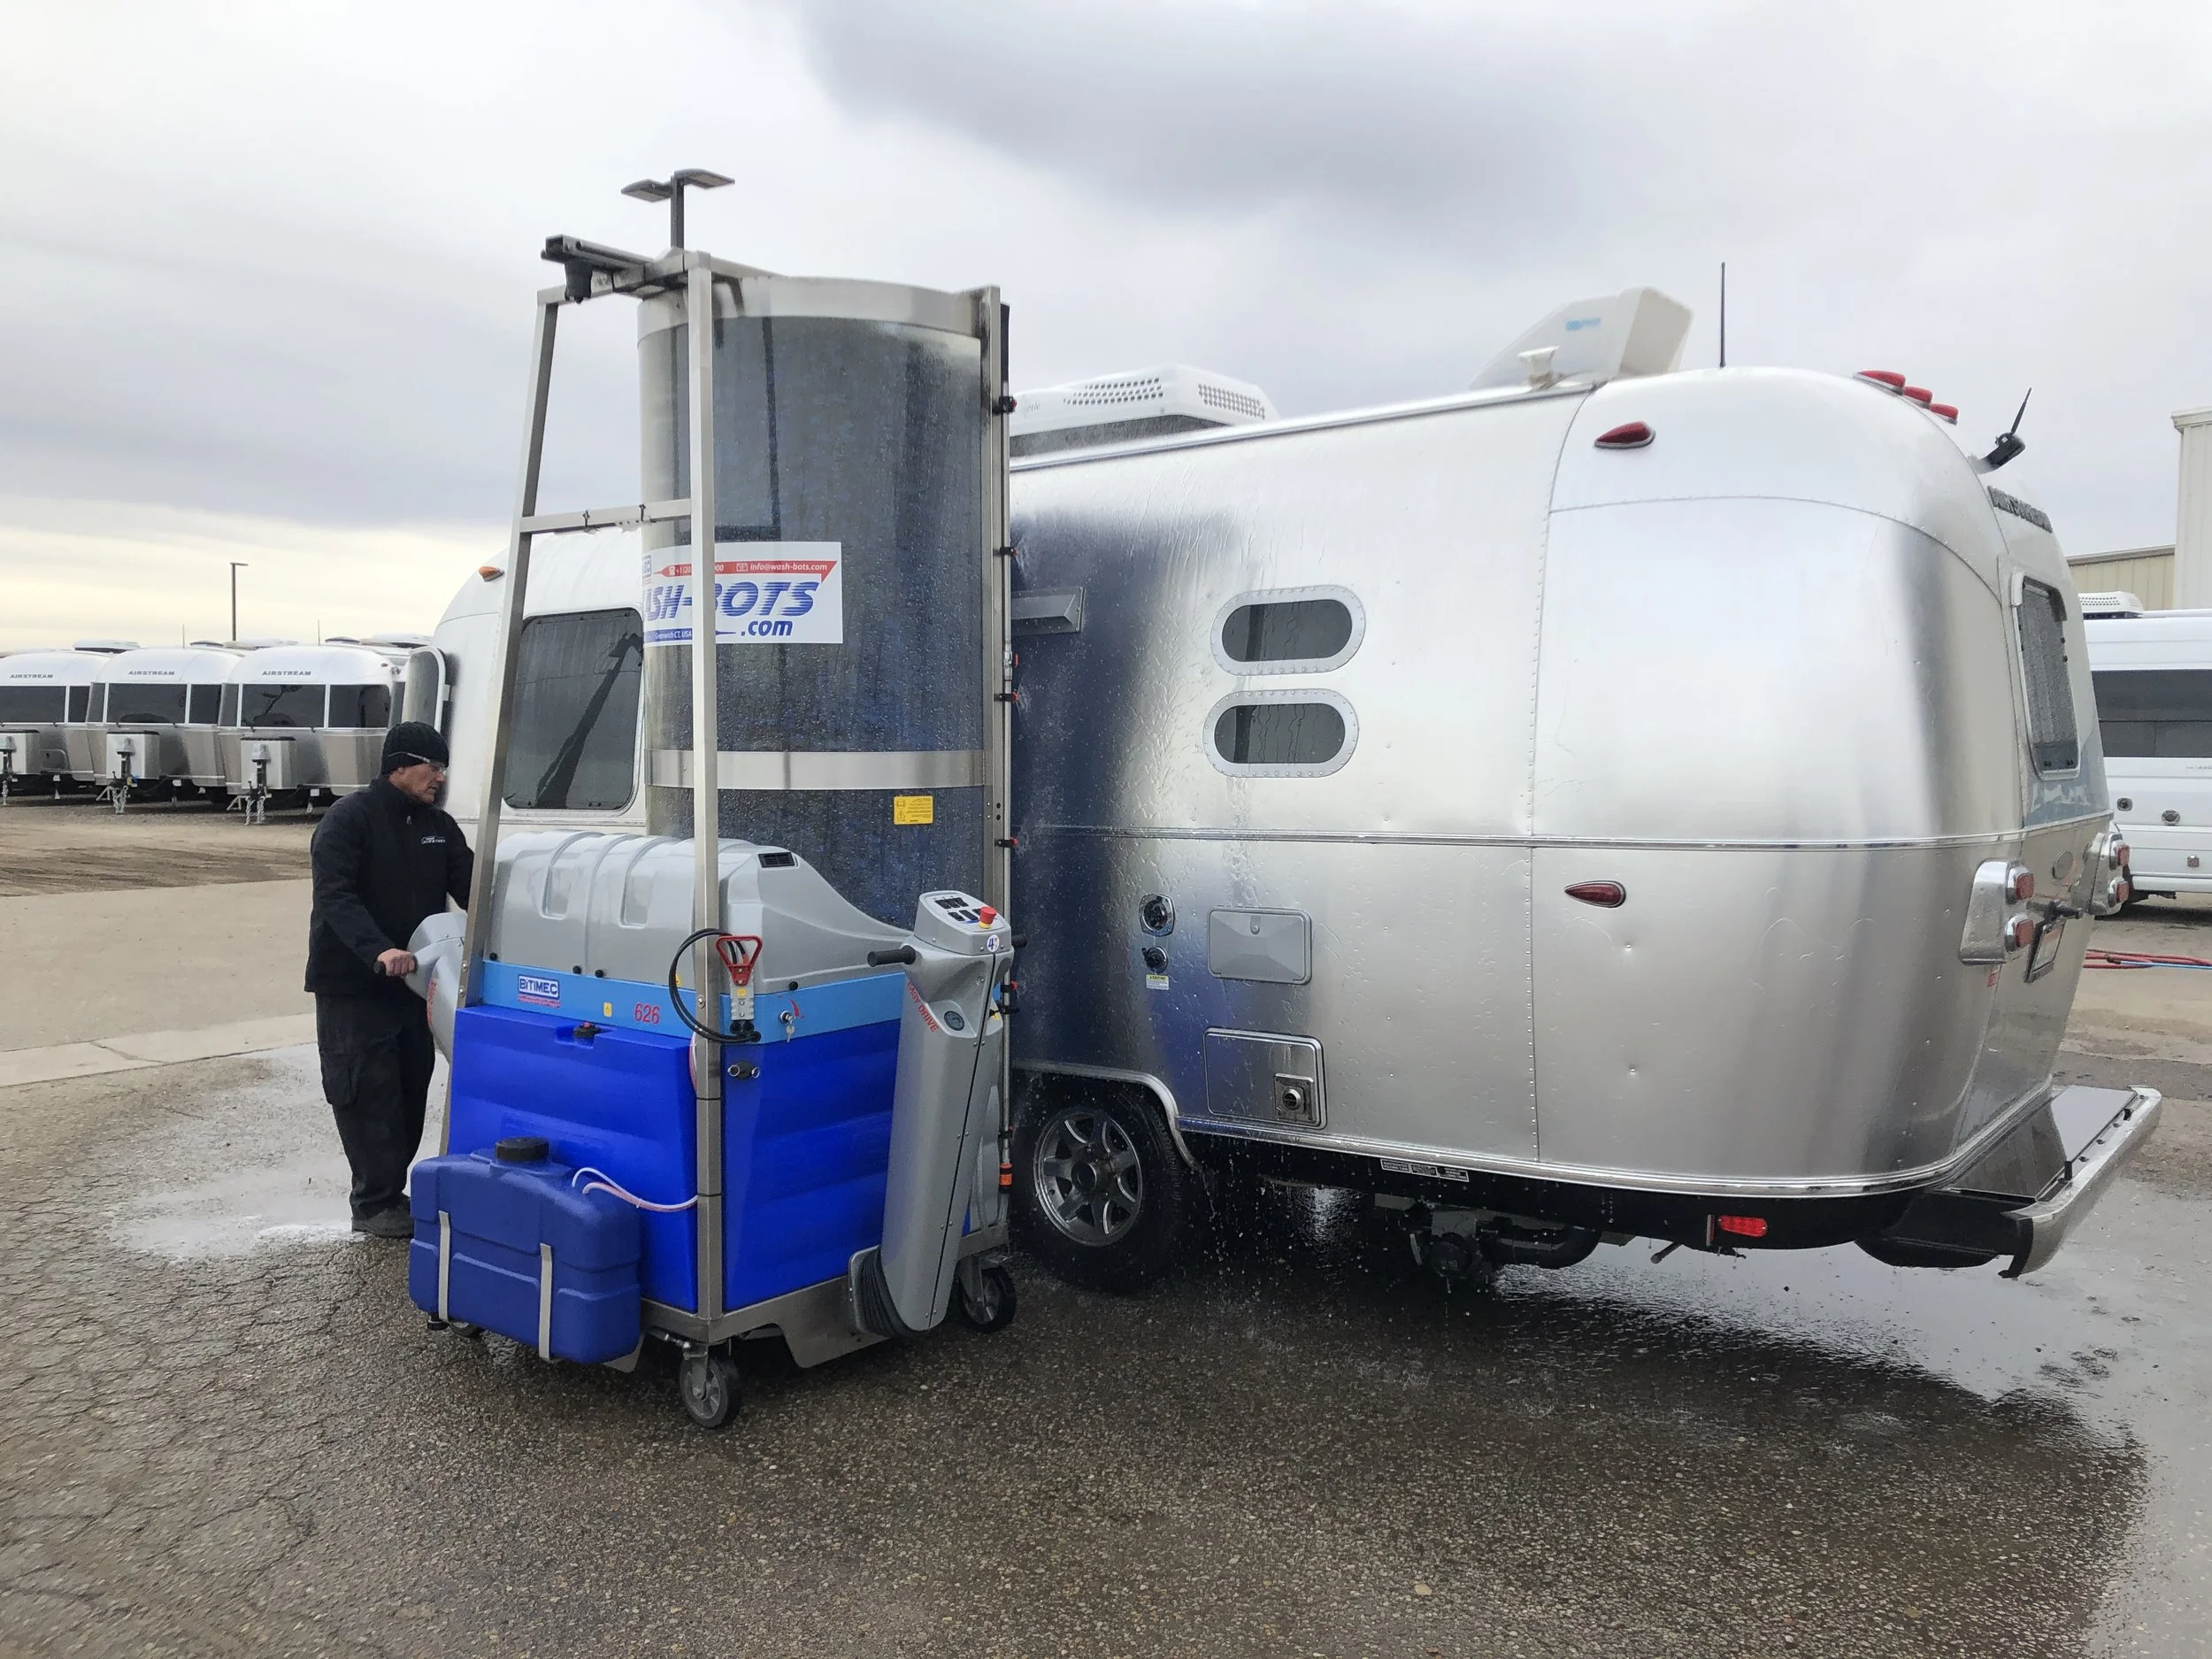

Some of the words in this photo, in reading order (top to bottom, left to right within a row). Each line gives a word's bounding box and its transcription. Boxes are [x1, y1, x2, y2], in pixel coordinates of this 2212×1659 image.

[749, 562, 827, 572] info@wash-bots.com
[741, 620, 794, 636] .com
[634, 1002, 660, 1025] 626
[918, 1004, 939, 1032] DRIVE
